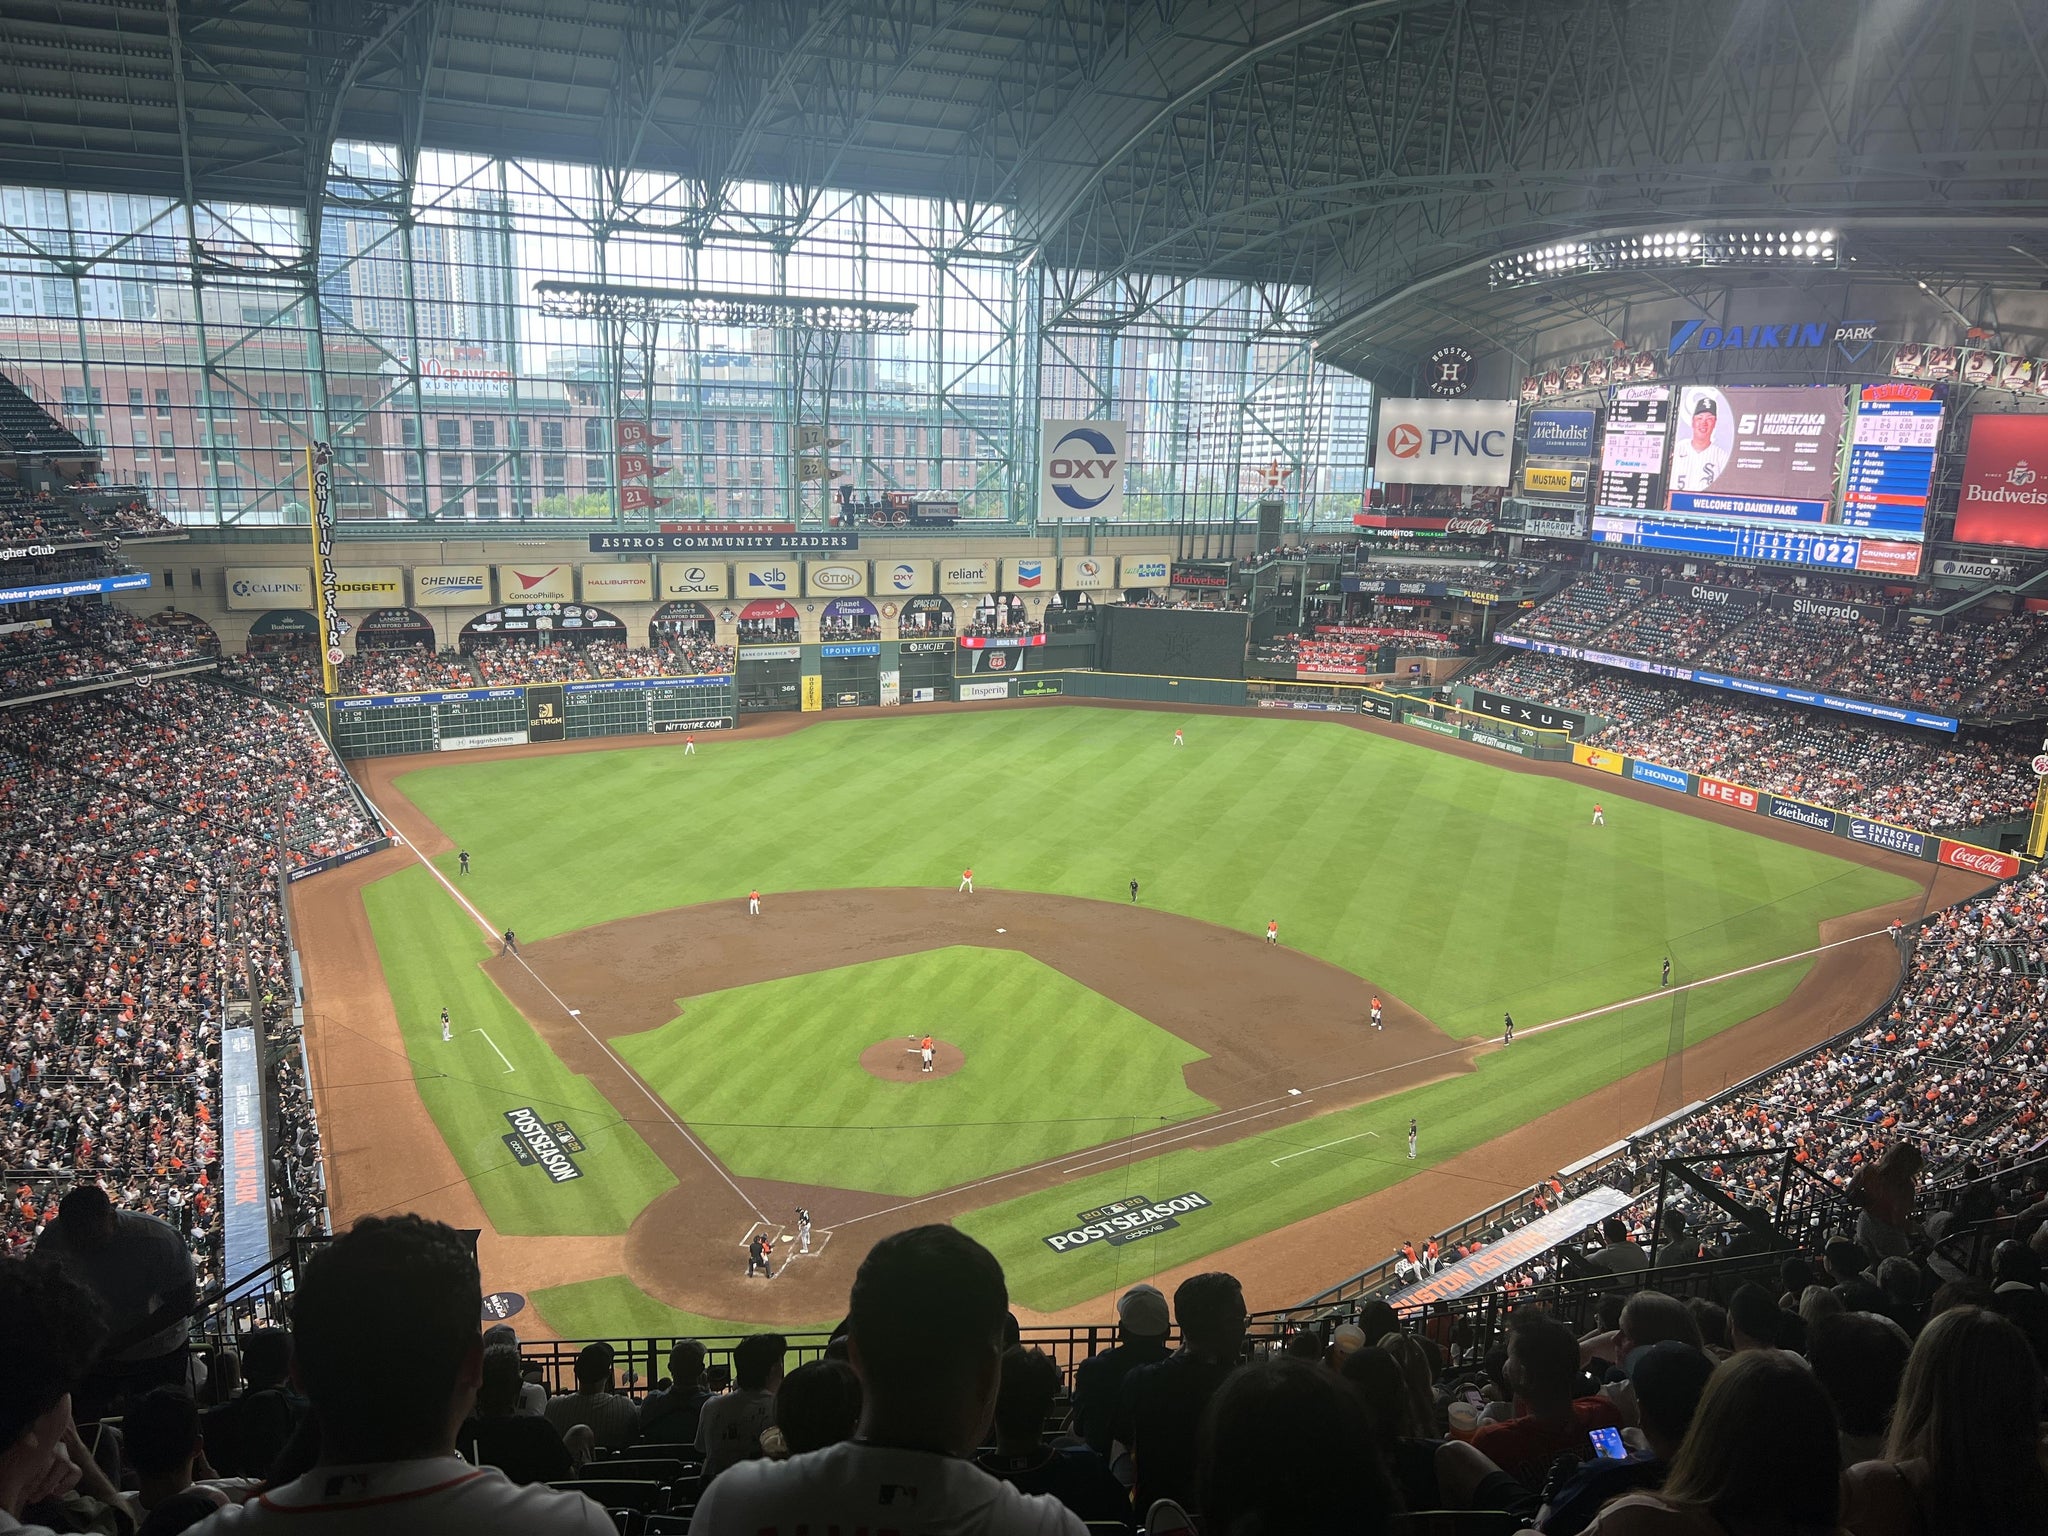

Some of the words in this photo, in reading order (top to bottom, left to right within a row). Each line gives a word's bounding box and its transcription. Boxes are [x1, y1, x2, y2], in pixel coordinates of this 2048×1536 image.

[1698, 322, 1828, 350] DAIKIN
[1834, 326, 1877, 341] PARK
[1432, 347, 1472, 362] HOUSTON
[1928, 345, 1954, 366] 24
[1971, 350, 1985, 371] 5
[1440, 363, 1460, 381] H
[2010, 356, 2025, 376] 7
[443, 368, 514, 383] CRAWFOR
[464, 383, 509, 391] LIVING
[1431, 382, 1467, 395] ASTROS
[1627, 387, 1657, 400] Chicago
[1872, 384, 1920, 400] ASTROS
[1738, 414, 1757, 435] 5
[1764, 414, 1825, 425] MUNETAKA
[1762, 425, 1822, 436] MURAKAMI
[623, 427, 640, 439] 05
[803, 432, 818, 443] 17
[1532, 424, 1589, 440] Methodist
[1428, 428, 1506, 457] PNC
[626, 460, 641, 473] 19
[803, 464, 818, 475] 22
[1049, 459, 1117, 479] OXY
[1532, 474, 1567, 486] MUSTANG
[1571, 476, 1586, 487] CAT
[626, 491, 641, 503] 21
[315, 472, 332, 555] CHIKIN
[1693, 499, 1732, 511] WELCOME
[1733, 501, 1744, 512] TO
[1745, 502, 1772, 513] DAIKIN
[1774, 503, 1798, 515] PARK
[1377, 529, 1414, 537] HORNITOS
[1534, 521, 1576, 536] HARGROVE
[1607, 521, 1624, 530] CWS
[1743, 535, 1749, 543] 4
[1759, 537, 1765, 545] 5
[1772, 538, 1778, 546] 0
[1785, 539, 1791, 547] 2
[602, 537, 665, 547] ASTROS
[673, 537, 773, 547] COMMUNITY
[781, 536, 848, 546] LEADERS
[1605, 532, 1622, 542] HOU
[1757, 548, 1764, 557] 2
[1770, 549, 1777, 558] 2
[1783, 550, 1790, 559] 2
[1797, 552, 1803, 561] 2
[28, 545, 56, 556] Club
[1862, 550, 1907, 560] GRUNDFOS
[1138, 564, 1166, 577] LNG
[1727, 562, 1756, 570] CHEVROLET
[764, 568, 786, 582] slb
[819, 572, 855, 585] COTTON
[948, 568, 984, 579] reliant
[1172, 574, 1227, 586] Budweiser
[421, 576, 483, 586] CHENIERE
[0, 591, 27, 600] Water
[29, 587, 62, 598] powers
[63, 583, 102, 594] gameday
[252, 583, 302, 593] CALPINE
[334, 584, 396, 592] DOGGETT
[669, 585, 719, 593] LEXUS
[509, 592, 564, 600] ConocoPhillips
[1378, 594, 1431, 607] Budweiser
[1464, 590, 1499, 601] PLUCKERS
[1691, 586, 1729, 606] Chevy
[835, 600, 860, 608] planet
[912, 600, 929, 608] SPACE
[930, 600, 942, 608] CITY
[1792, 600, 1860, 621] Silverado
[325, 590, 340, 647] FAIR
[1340, 627, 1380, 635] Budweiser
[1403, 630, 1438, 640] Budweiser
[825, 646, 878, 654] 1POINTFIVE
[917, 643, 946, 652] EMCJET
[991, 658, 1003, 666] 66
[1317, 665, 1358, 674] Budweiser
[971, 686, 1007, 697] Insperity
[1732, 680, 1742, 689] We
[1759, 686, 1778, 695] water
[1824, 698, 1843, 708] Water
[1845, 702, 1872, 714] powers
[1872, 707, 1906, 720] gameday
[530, 717, 562, 725] BETMGM
[1482, 700, 1574, 730] LEXUS
[431, 706, 439, 749] NATIONAL
[665, 720, 722, 731] NITTOTIRE.COM
[1414, 717, 1432, 729] National
[1440, 726, 1453, 734] Rental
[1472, 733, 1487, 744] SPACE
[1487, 736, 1497, 745] CITY
[1522, 729, 1533, 737] 370
[469, 736, 513, 744] Higginbotham
[1644, 768, 1686, 786] HONDA
[1775, 800, 1797, 808] HOUSTON
[1774, 805, 1828, 828] Methodist
[1869, 824, 1911, 842] ENERGY
[1868, 834, 1920, 854] TRANSFER
[344, 848, 369, 860] NUTRAFOL
[236, 1084, 250, 1112] WELCOME
[236, 1113, 249, 1125] TO
[234, 1128, 255, 1167] DAIKIN
[508, 1109, 578, 1181] POSTSEASON
[235, 1168, 258, 1205] PARK
[1083, 1210, 1102, 1220] 20
[1047, 1193, 1207, 1251] POSTSEASON
[1470, 1230, 1552, 1288] ASTROS
